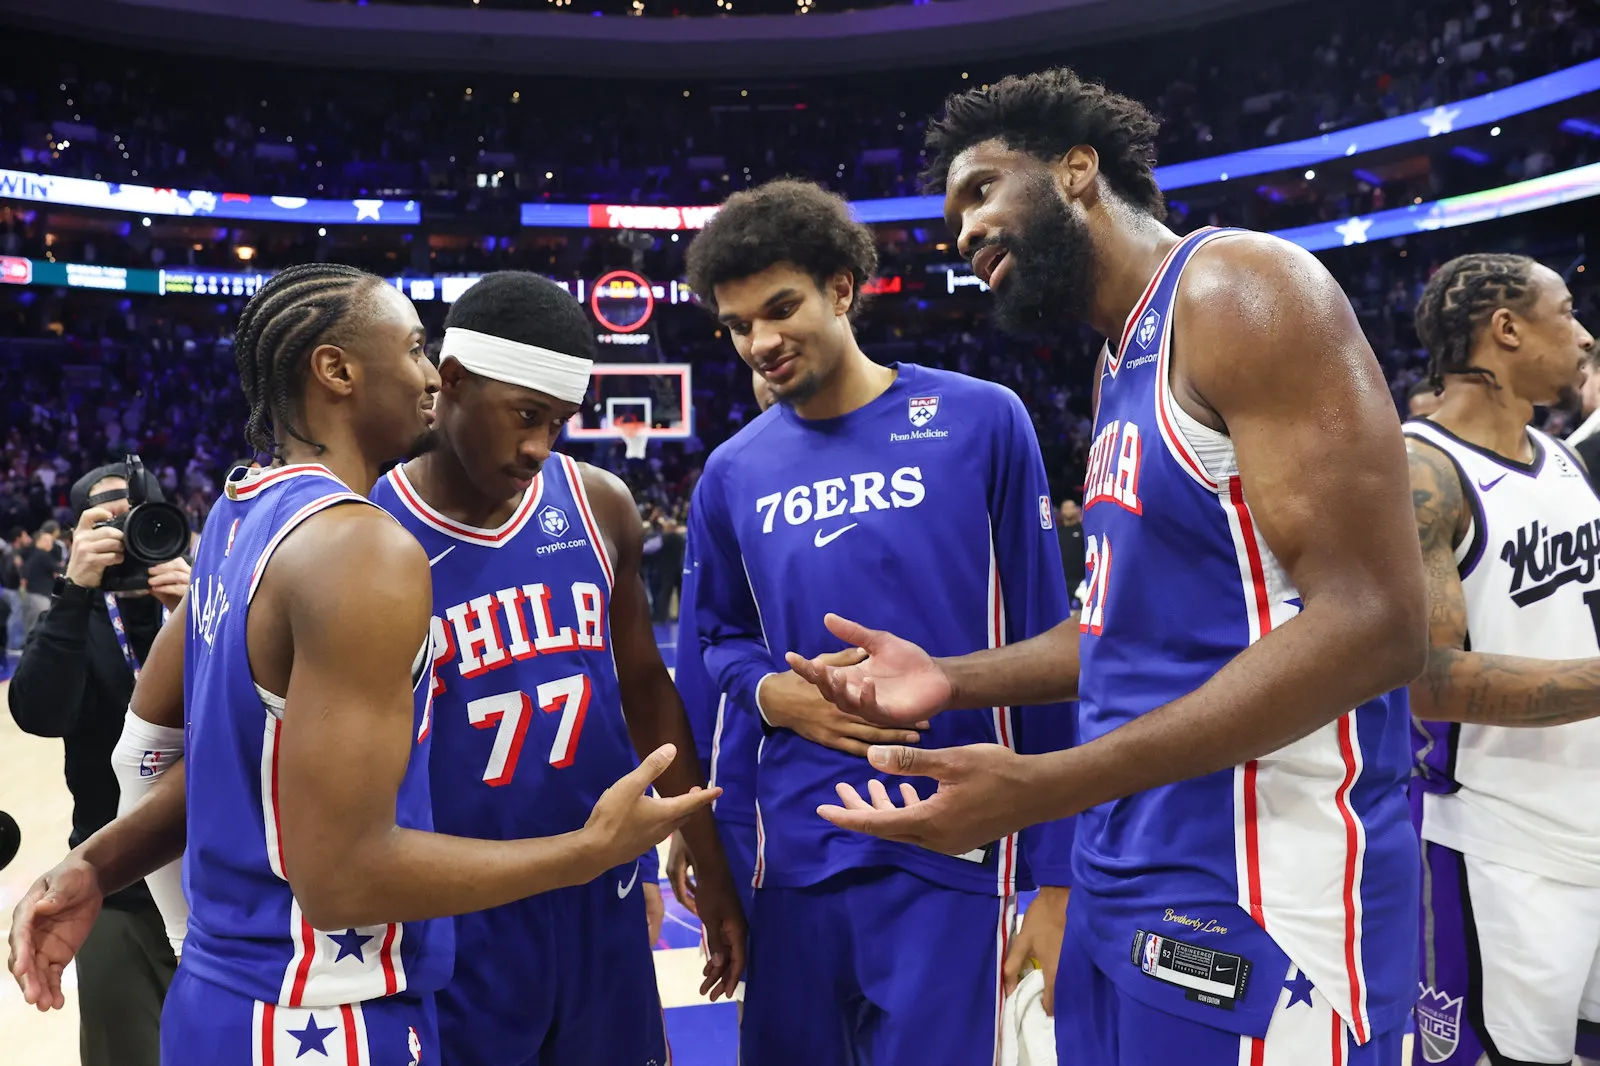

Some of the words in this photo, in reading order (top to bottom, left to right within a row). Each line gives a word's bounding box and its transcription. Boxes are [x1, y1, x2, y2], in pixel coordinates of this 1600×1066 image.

[1126, 353, 1159, 370] crypto.com
[890, 432, 910, 442] Penn
[910, 428, 949, 440] Medicine
[756, 466, 926, 534] 76ERS
[536, 538, 587, 555] crypto.com
[1500, 518, 1600, 608] King
[1079, 532, 1112, 637] 21
[466, 673, 593, 788] 77
[1162, 908, 1204, 932] Brotherly
[1202, 919, 1228, 935] Love
[1162, 949, 1171, 959] 52
